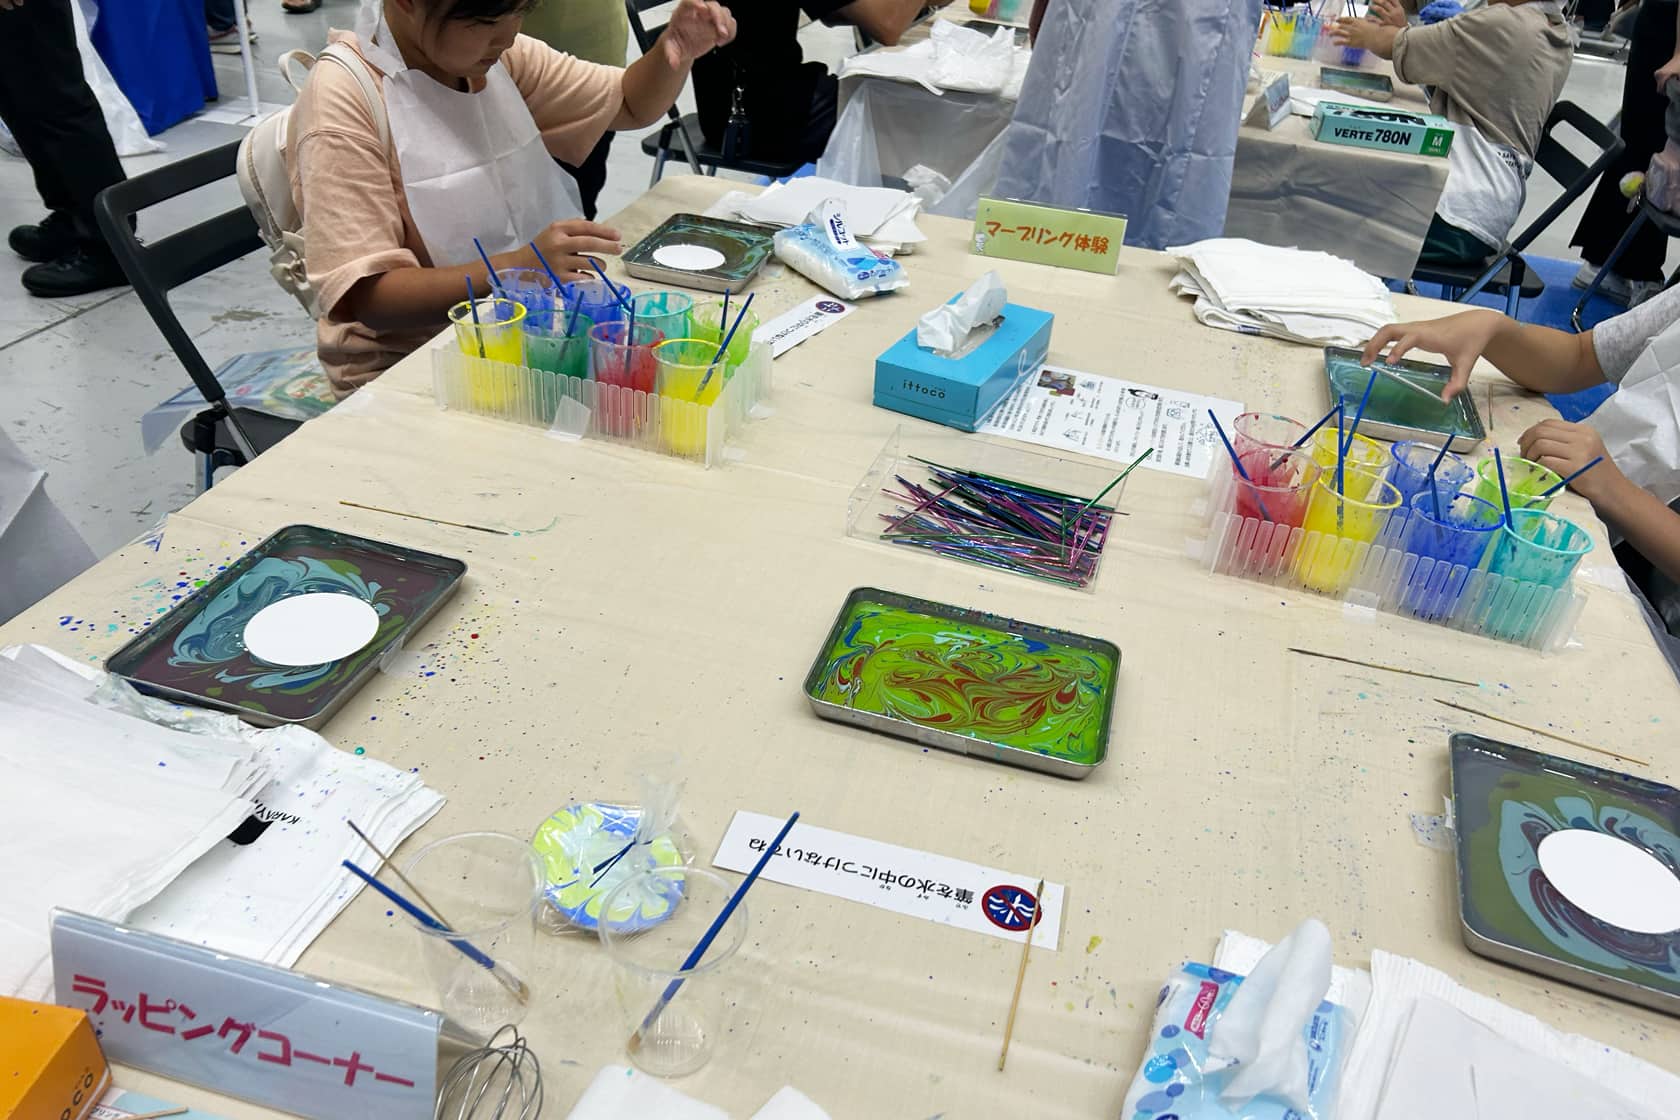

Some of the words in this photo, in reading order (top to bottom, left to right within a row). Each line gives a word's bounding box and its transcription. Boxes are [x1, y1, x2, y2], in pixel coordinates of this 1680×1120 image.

[1334, 127, 1374, 142] VERTE
[1374, 128, 1411, 146] 780N
[1432, 135, 1443, 147] M
[903, 379, 946, 399] ittoco
[254, 799, 301, 825] KARAY
[72, 973, 415, 1088] ラッピングコーナー
